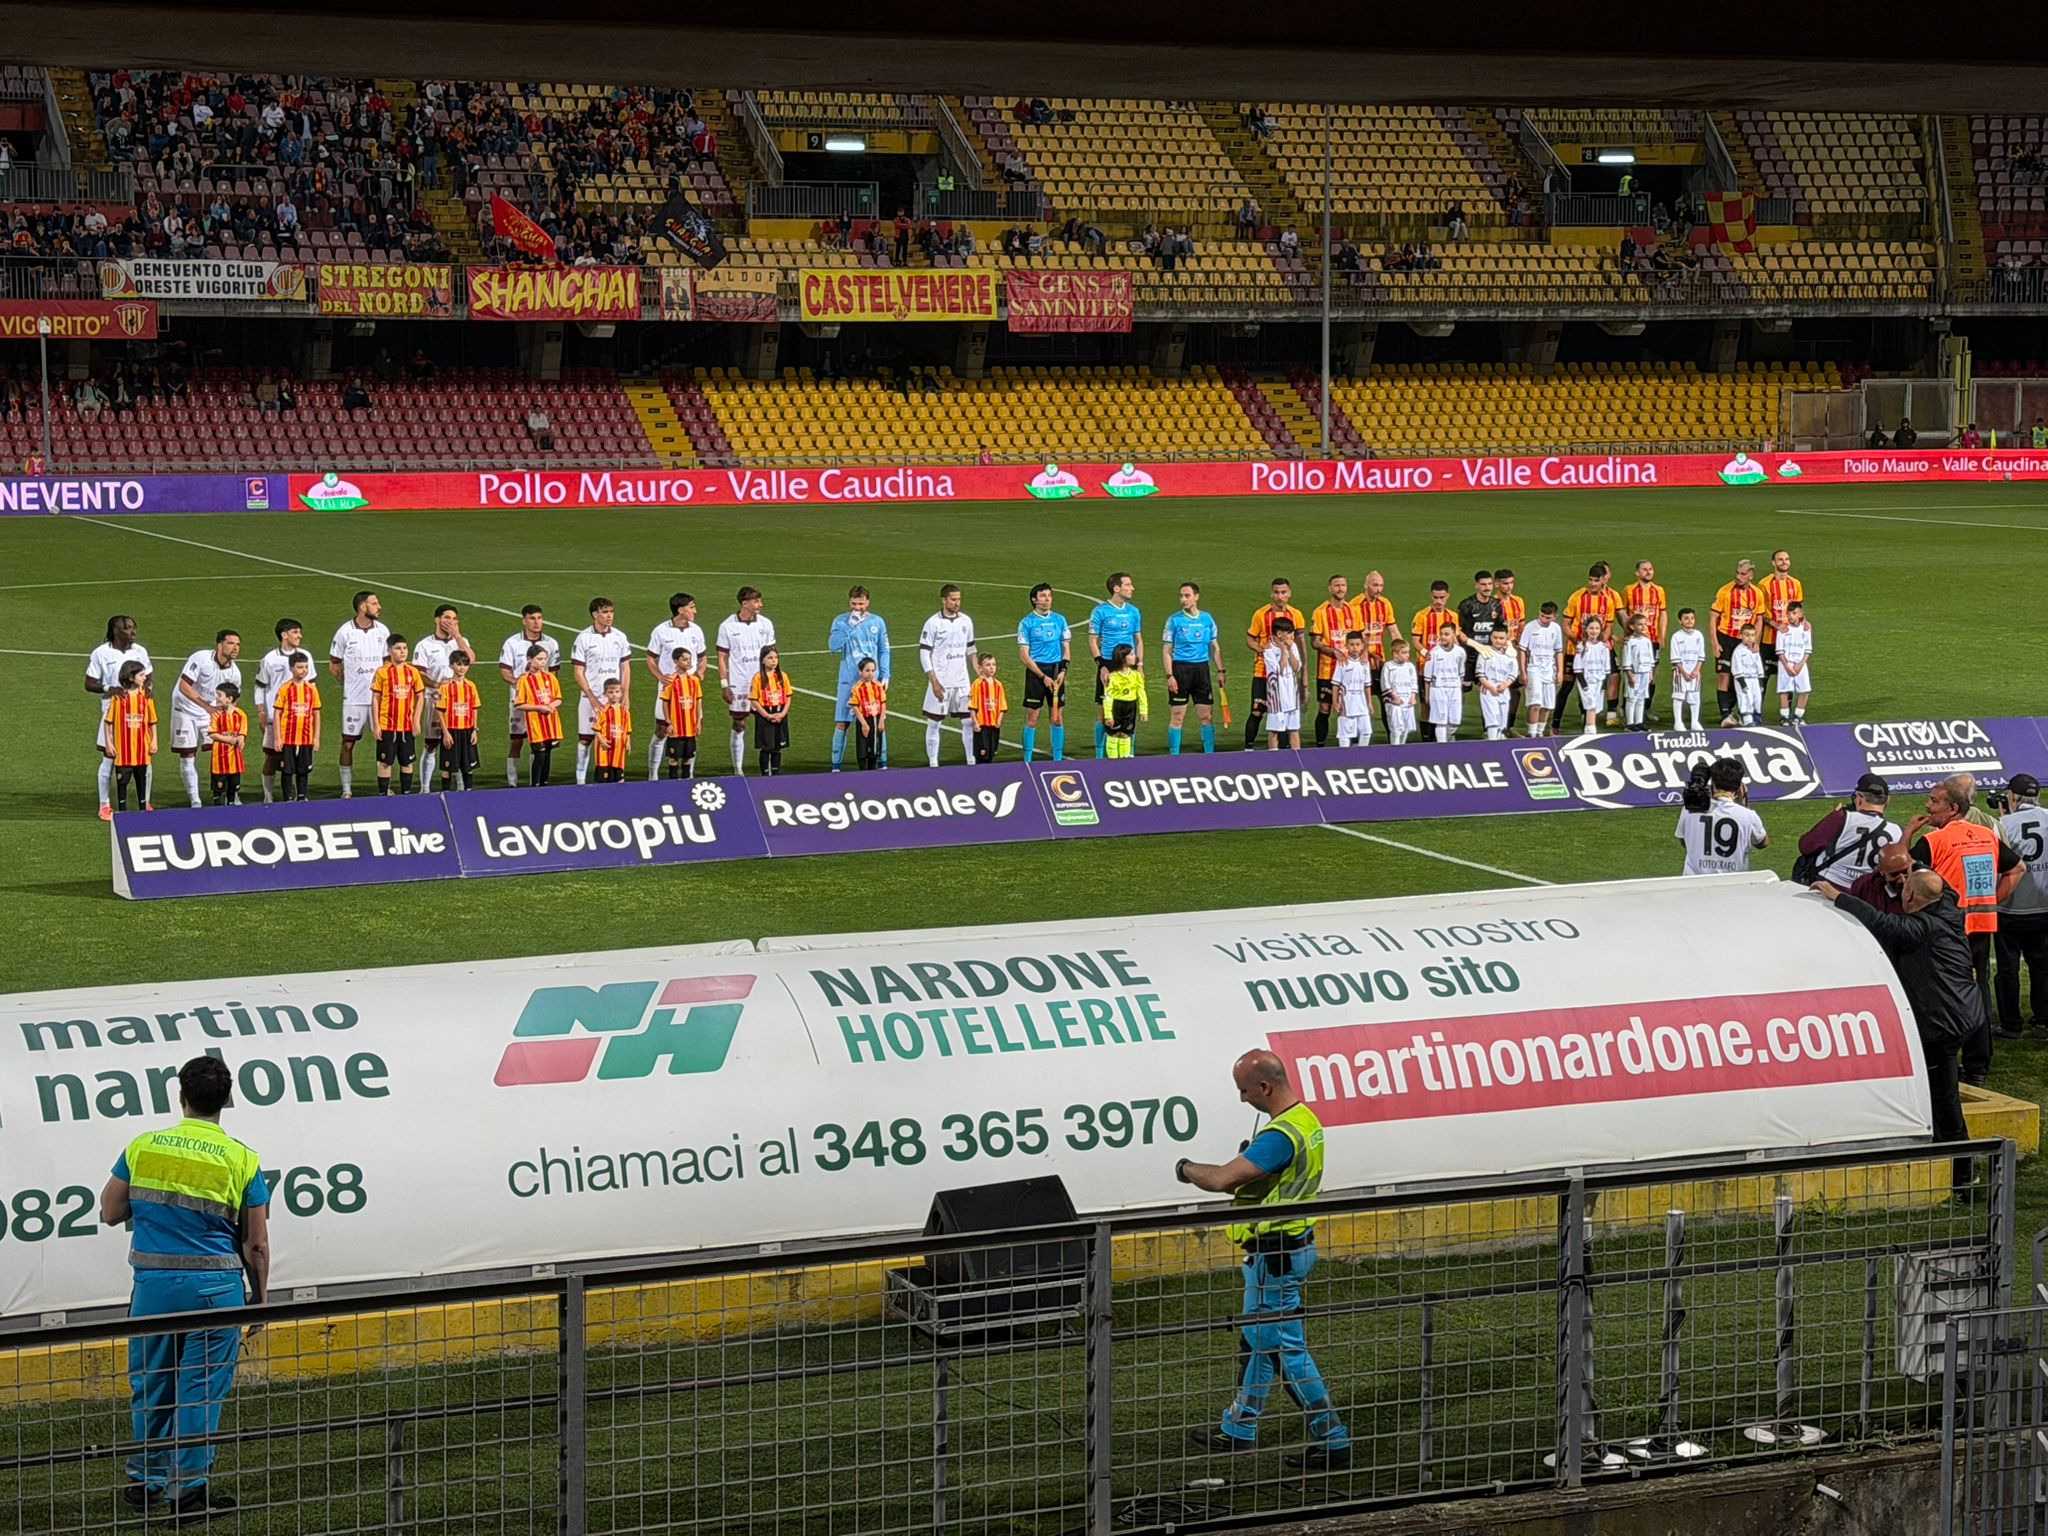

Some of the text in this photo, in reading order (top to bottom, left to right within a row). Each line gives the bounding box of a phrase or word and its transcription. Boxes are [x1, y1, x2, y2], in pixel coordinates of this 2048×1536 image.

[810, 135, 819, 147] 9
[133, 263, 264, 278] BENEVENTO CLUB
[319, 264, 450, 290] STREGONI
[1039, 274, 1101, 294] GENS
[135, 279, 266, 295] ORESTE VIGORITO
[471, 269, 637, 315] SHANGHAI
[804, 273, 993, 316] CASTELVENERE
[321, 291, 425, 314] DEL NORD
[1010, 298, 1130, 317] SAMNITES
[1252, 462, 1325, 490] Pollo
[1334, 461, 1432, 489] Mauro
[1461, 459, 1531, 487] Valle
[1540, 457, 1658, 485] Caudina
[1844, 459, 1879, 473] Pollo
[1882, 459, 1929, 473] Mauro
[1942, 458, 1977, 471] Valle
[1981, 457, 2048, 471] Caudina
[480, 474, 566, 504] Pollo
[578, 473, 693, 502] Mauro
[727, 470, 808, 501] Valle
[819, 468, 955, 499] Caudina
[1647, 732, 1710, 750] Fratelli
[1854, 720, 1992, 748] CATTOLICA
[1866, 746, 1998, 763] ASSICURAZIONI
[1104, 761, 1509, 809] SUPERCOPPA REGIONALE
[1887, 780, 1913, 792] archio
[1914, 778, 1924, 789] di
[763, 786, 976, 831] Regionale
[1698, 815, 1740, 858] 19
[2021, 821, 2044, 862] 5
[1965, 860, 1993, 874] STEWARD
[1968, 876, 1993, 891] 1664
[1213, 917, 1582, 965] visita il nostro
[808, 948, 1152, 1008] NARDONE
[1243, 954, 1521, 1013] nuovo sito
[19, 1001, 360, 1052] martino
[835, 992, 1177, 1064] HOTELLERIE
[1295, 1009, 1887, 1103] martinonardone.com
[150, 1133, 228, 1157] MISERICORDIE
[507, 1095, 1200, 1199] chiamaci al 348 365 3970
